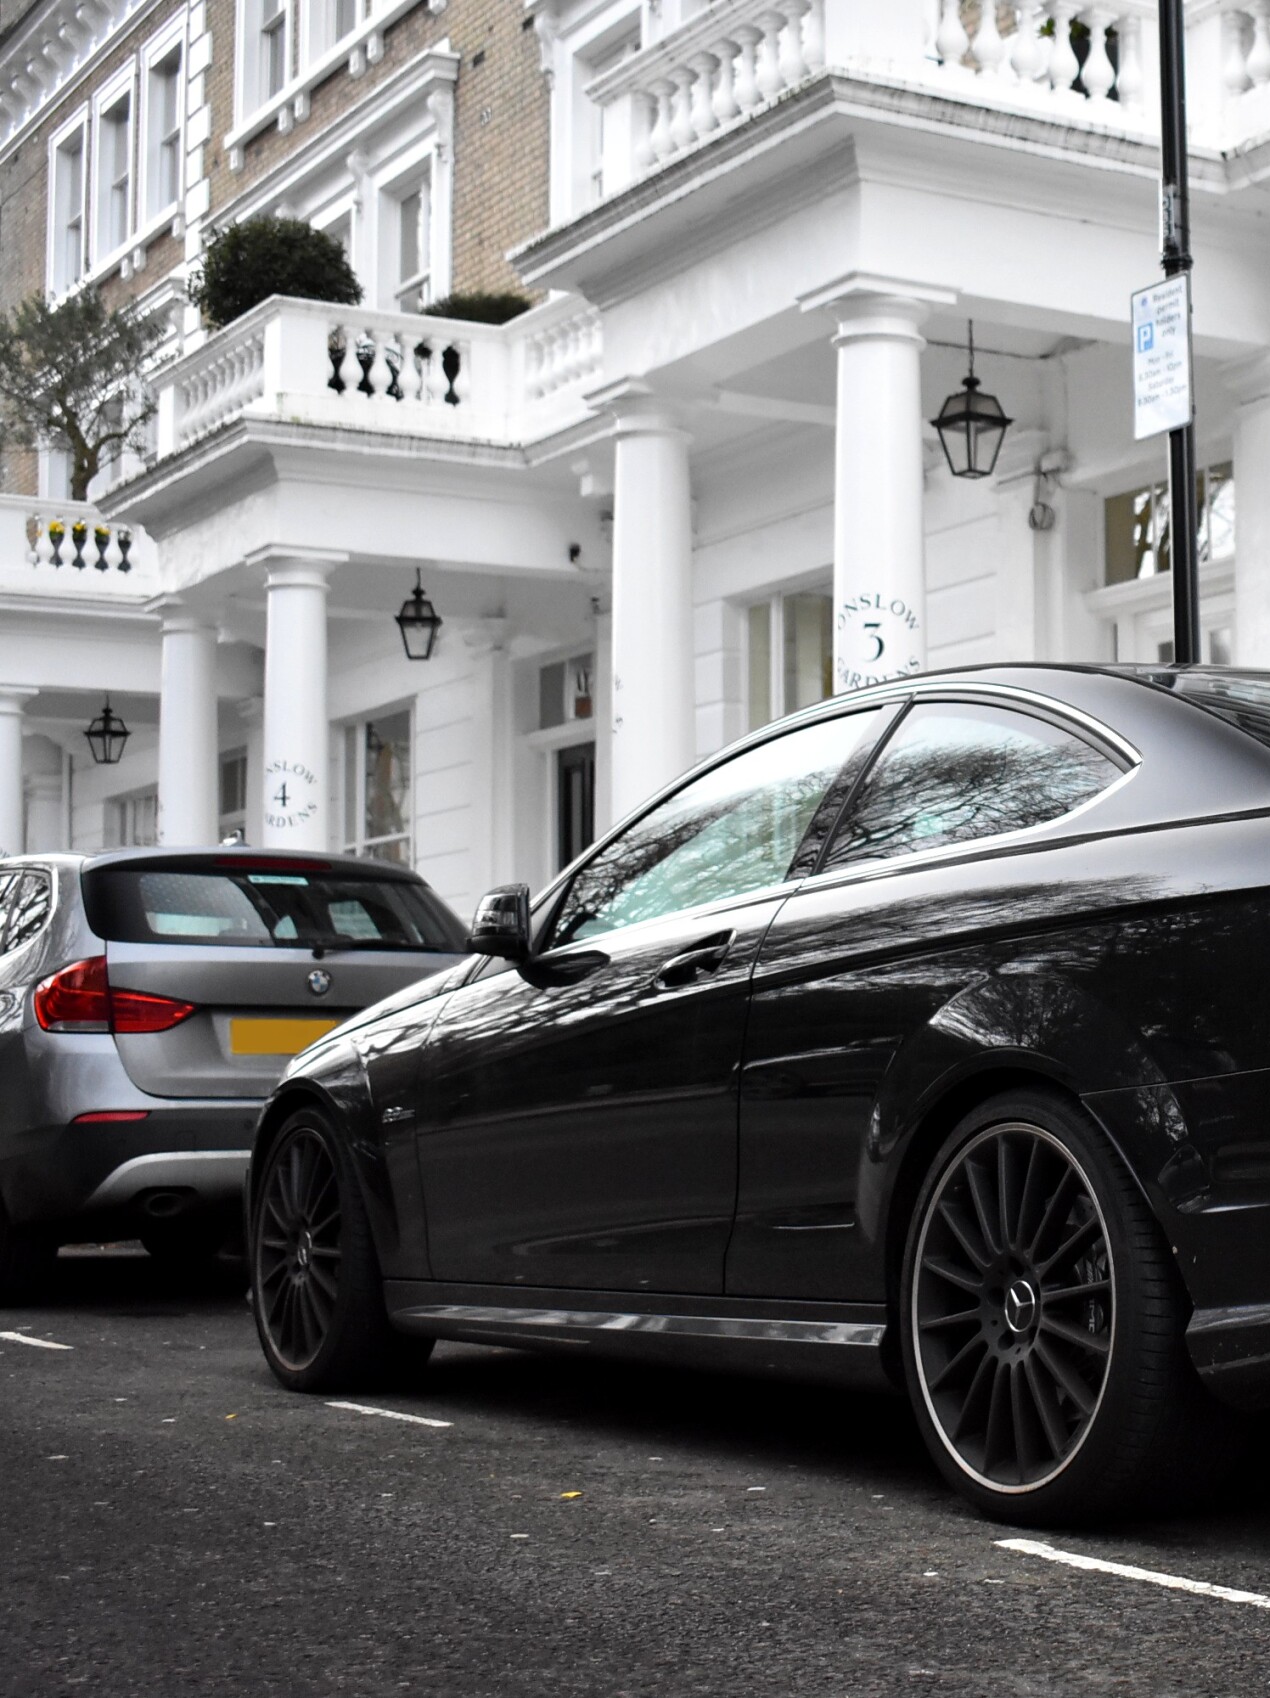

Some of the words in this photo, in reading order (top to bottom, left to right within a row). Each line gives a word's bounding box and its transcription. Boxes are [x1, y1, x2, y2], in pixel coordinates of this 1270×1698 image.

[1152, 285, 1183, 302] Resident
[1156, 298, 1180, 315] permit
[1155, 312, 1181, 327] holders
[863, 623, 885, 662] 3
[274, 782, 291, 807] 4
